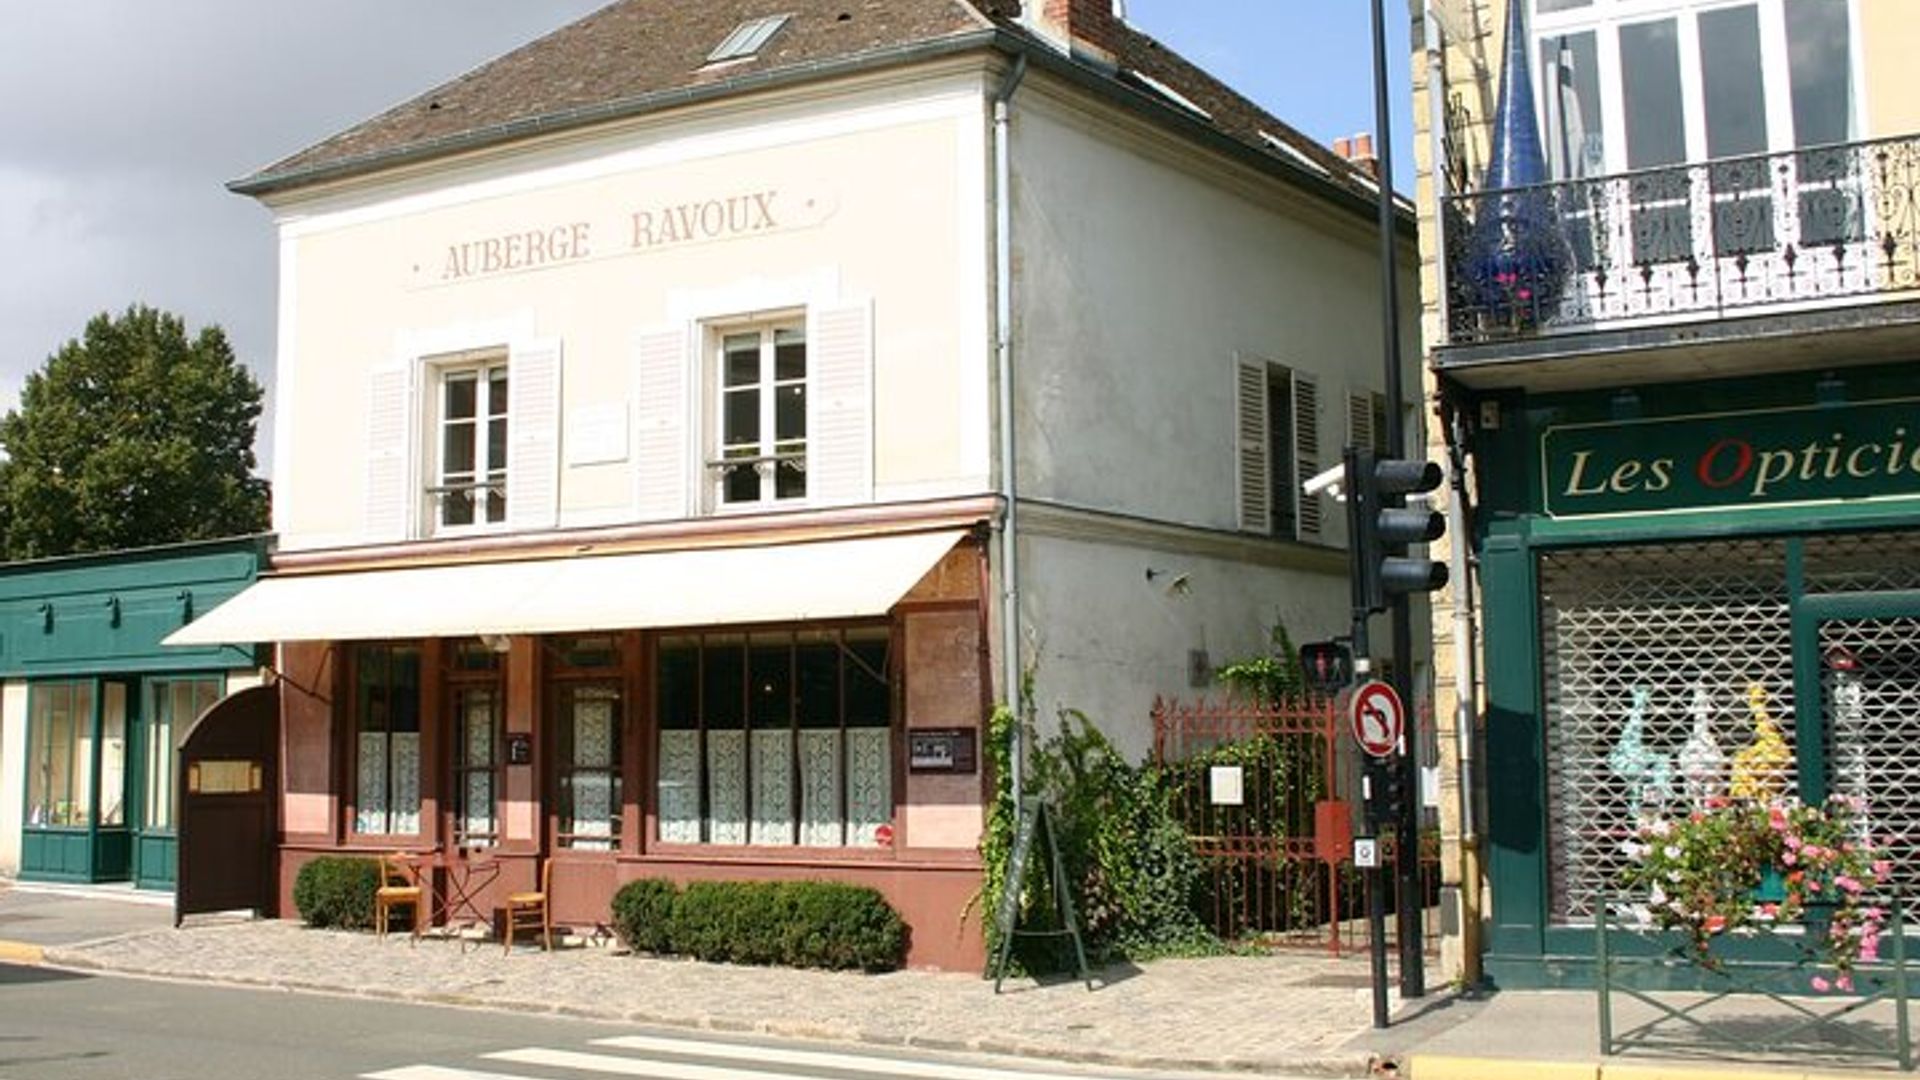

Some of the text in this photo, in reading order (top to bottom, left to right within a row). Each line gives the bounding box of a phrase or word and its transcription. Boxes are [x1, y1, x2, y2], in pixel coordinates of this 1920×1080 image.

[442, 191, 777, 280] AUBERGE RAVOUX
[1563, 451, 1674, 496] Les
